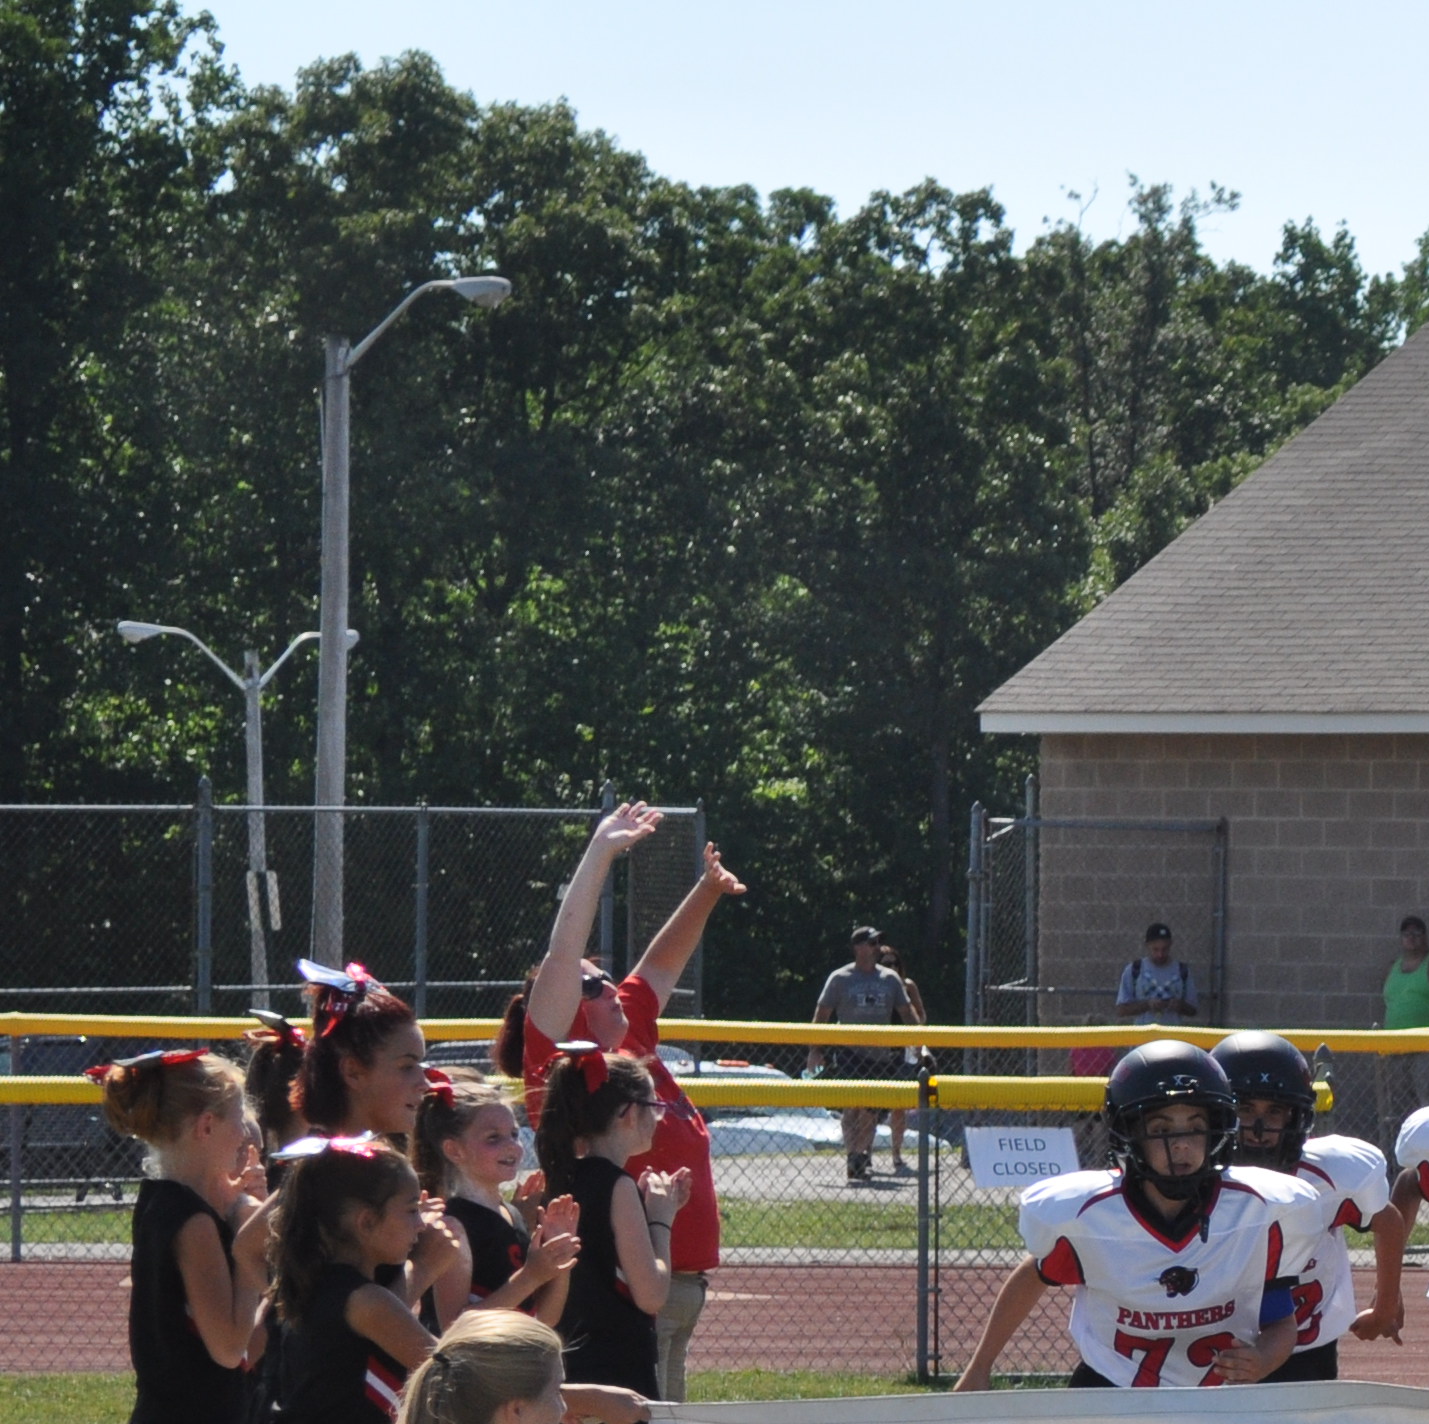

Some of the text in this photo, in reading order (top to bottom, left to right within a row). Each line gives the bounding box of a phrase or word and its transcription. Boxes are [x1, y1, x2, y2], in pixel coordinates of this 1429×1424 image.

[998, 1138, 1046, 1152] FIELD
[993, 1162, 1061, 1176] CLOSED
[1116, 1299, 1236, 1330] PANTHERS
